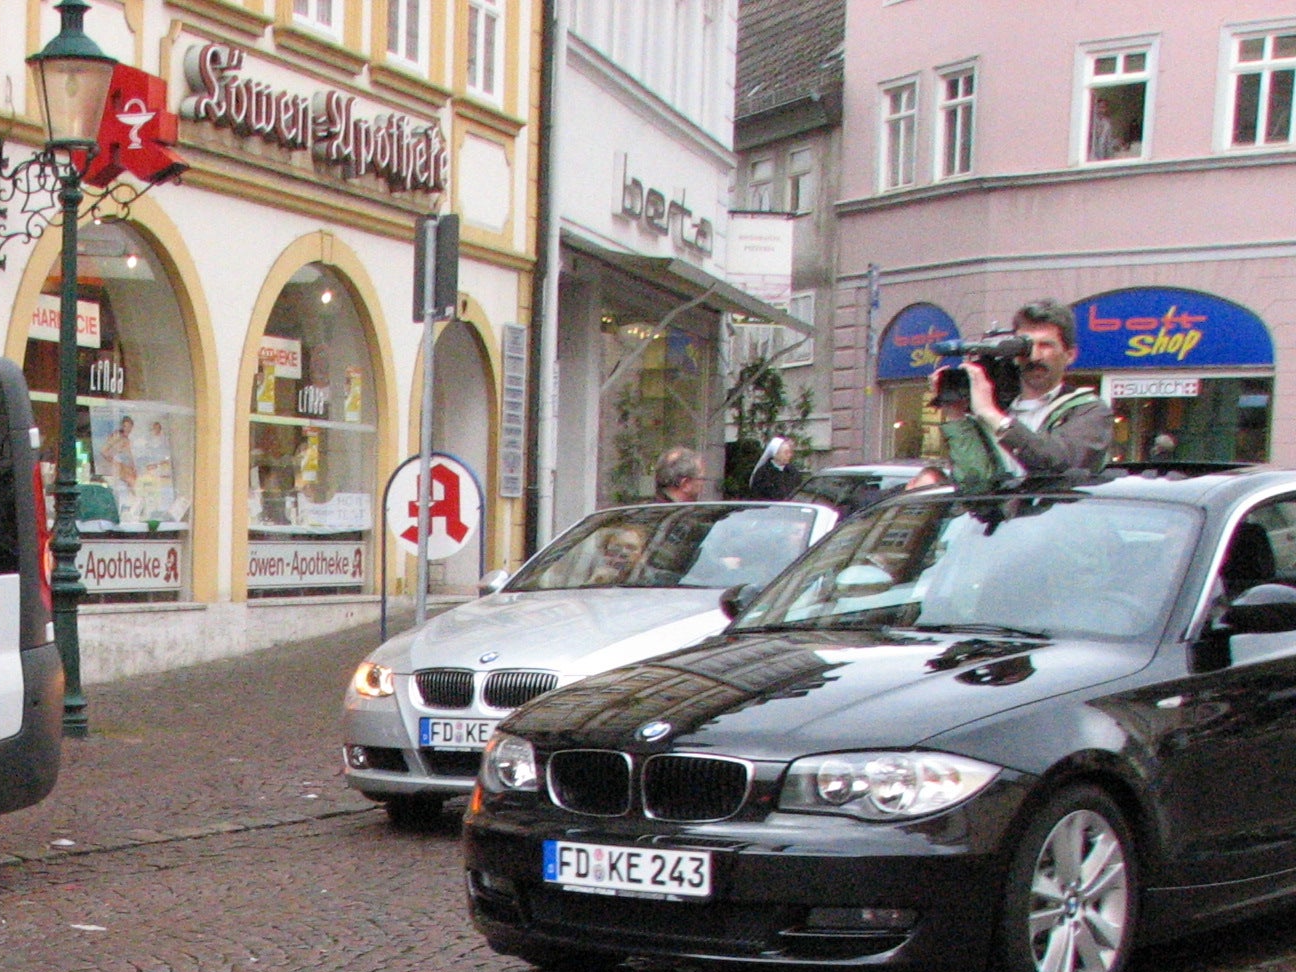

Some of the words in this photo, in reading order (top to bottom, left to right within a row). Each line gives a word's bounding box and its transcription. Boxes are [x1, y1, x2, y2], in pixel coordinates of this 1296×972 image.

[1088, 305, 1207, 331] bott
[1125, 325, 1202, 361] shop
[1125, 378, 1184, 396] swatch
[247, 551, 349, 583] öwen-Apotheke
[431, 721, 454, 742] FD
[466, 723, 489, 742] KE
[559, 846, 590, 878] FD
[608, 851, 643, 884] KE
[651, 854, 704, 888] 243
